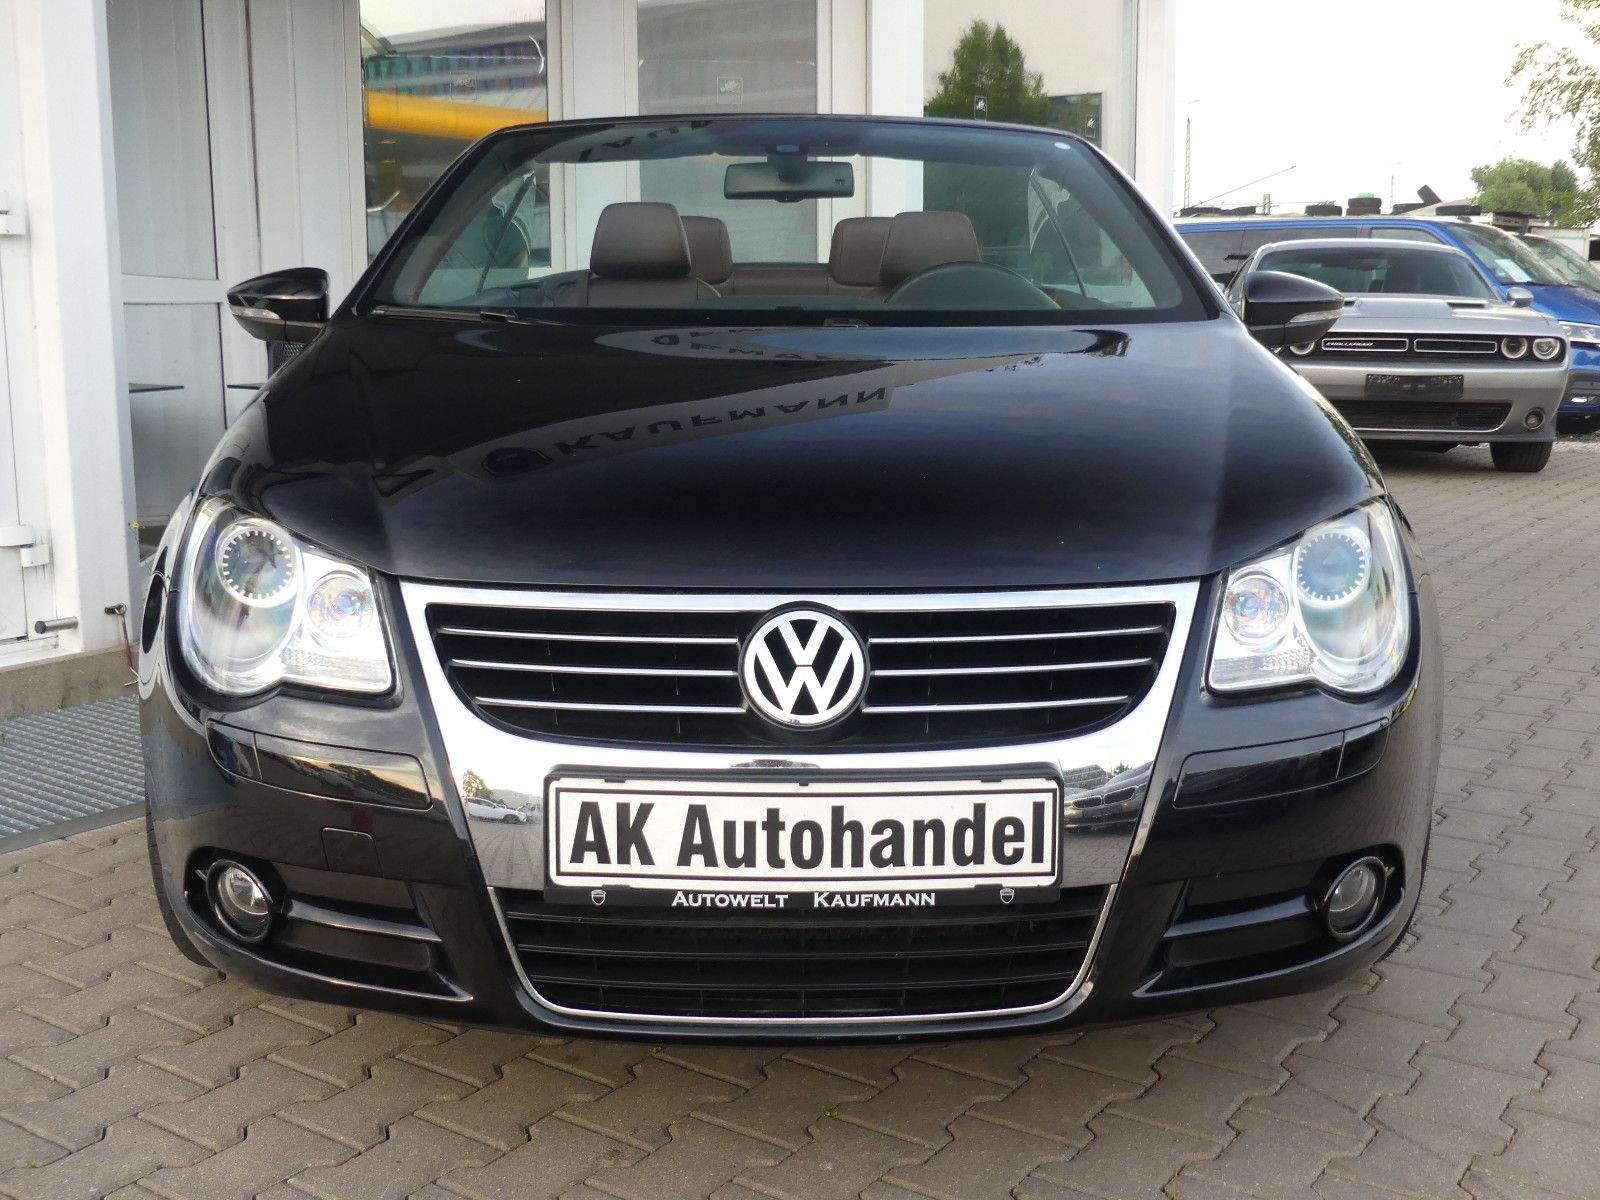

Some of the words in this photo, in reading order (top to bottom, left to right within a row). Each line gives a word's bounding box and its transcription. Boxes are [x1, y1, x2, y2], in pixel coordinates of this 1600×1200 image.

[570, 801, 656, 866] AK
[676, 801, 1046, 869] Autohandel
[671, 890, 789, 908] AUTOWELT
[813, 891, 937, 908] KAUFMANN
